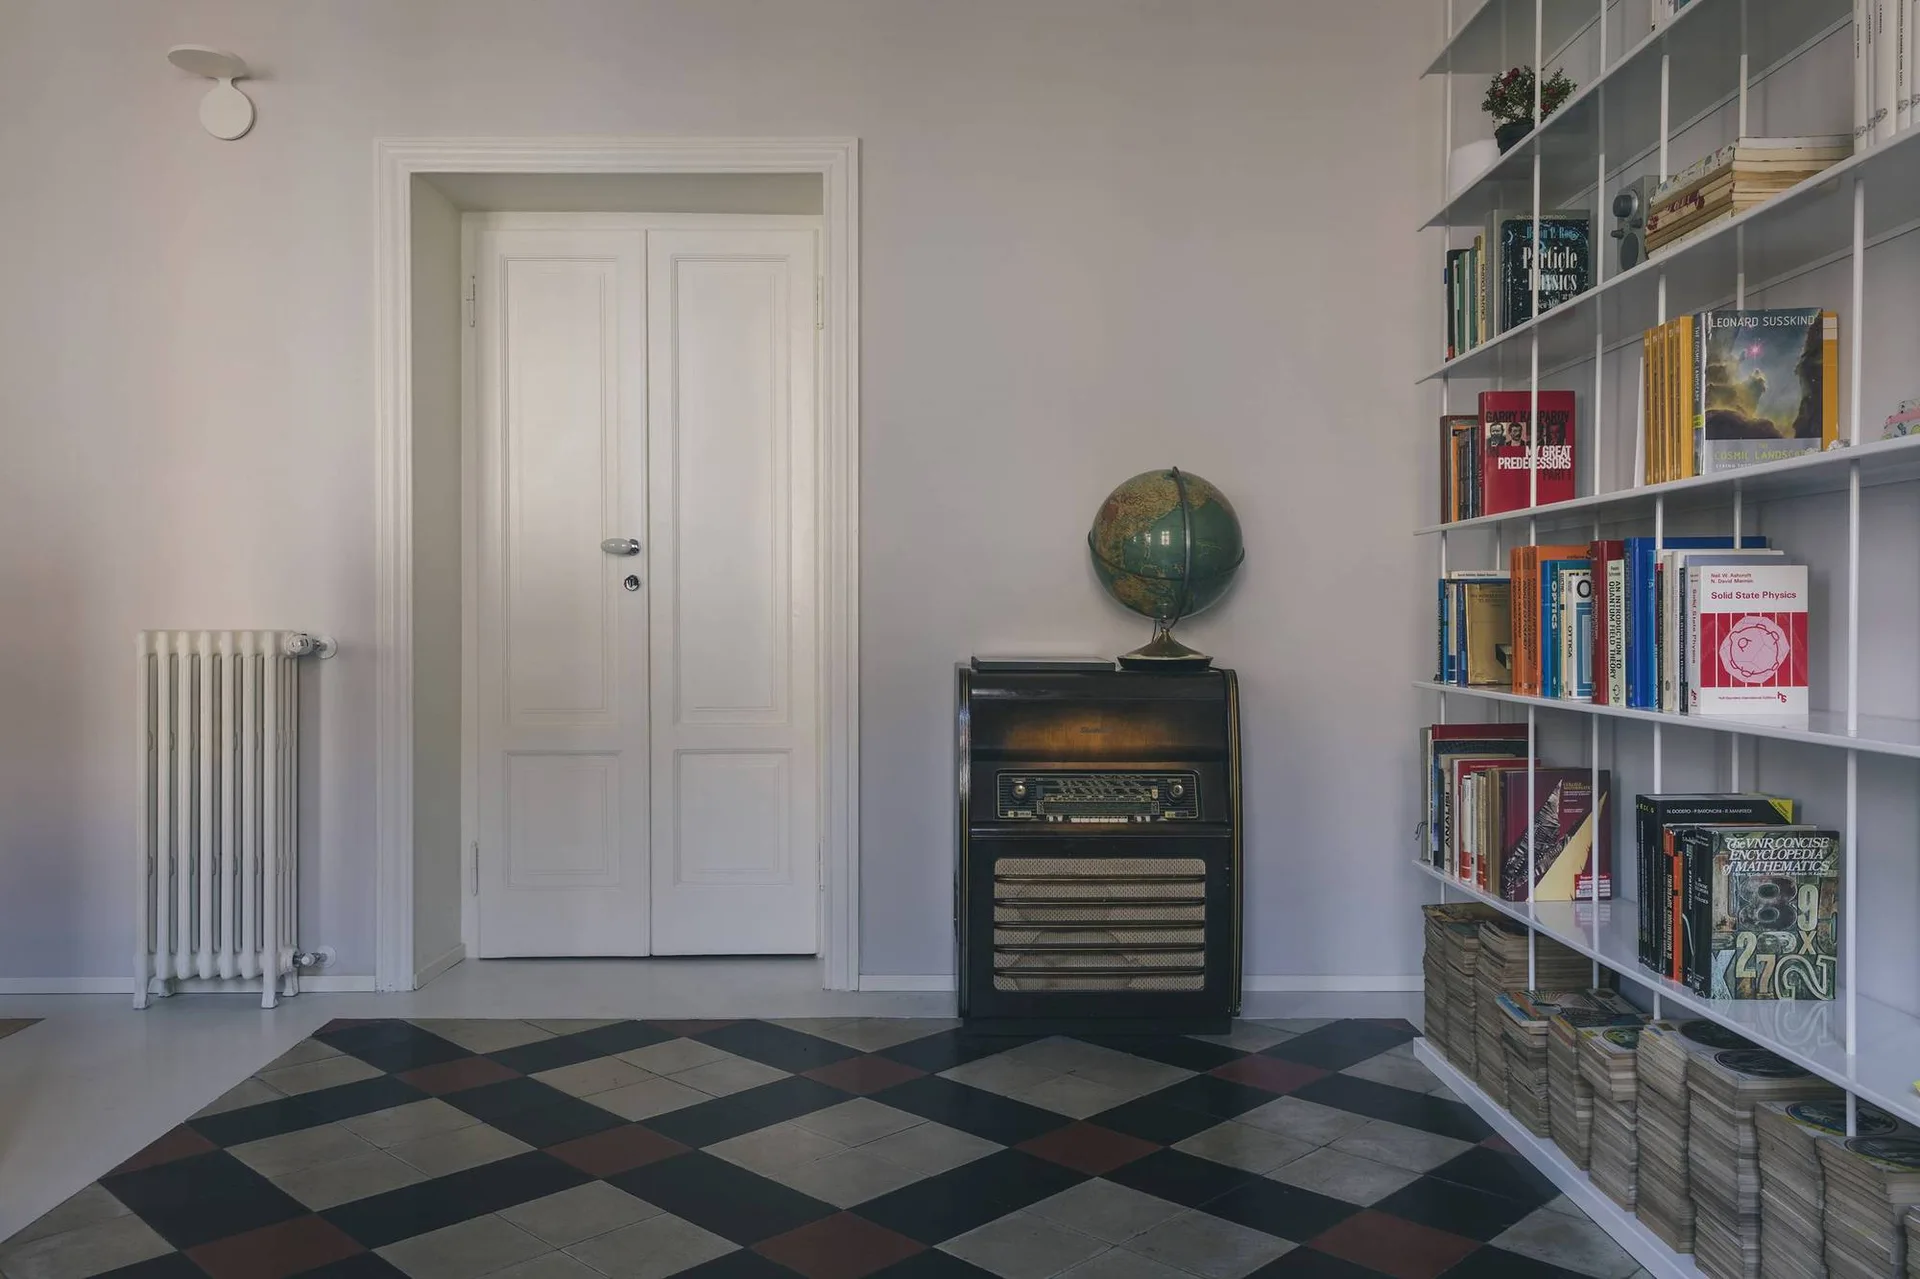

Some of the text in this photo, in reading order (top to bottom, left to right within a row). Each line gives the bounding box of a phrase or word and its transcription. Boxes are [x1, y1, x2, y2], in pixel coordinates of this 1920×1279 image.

[1522, 246, 1578, 269] Prticle
[1711, 315, 1815, 327] LEONARD SUSSKIND
[1520, 410, 1570, 423] KAPAROV
[1542, 445, 1572, 458] GREAT
[1715, 450, 1749, 461] COSMIC
[1498, 457, 1572, 470] PREDEESSORS
[1615, 581, 1621, 590] AN
[1711, 590, 1797, 601] Solid State Physics
[1616, 658, 1622, 670] TO
[1725, 837, 1830, 850] The VNR CONCISE
[1729, 849, 1824, 861] ENCYCLOPEDIA
[1722, 860, 1831, 876] of MATHEMATICS
[1797, 883, 1819, 932] 9
[1736, 931, 1757, 978] 2
[1756, 954, 1776, 995] 7
